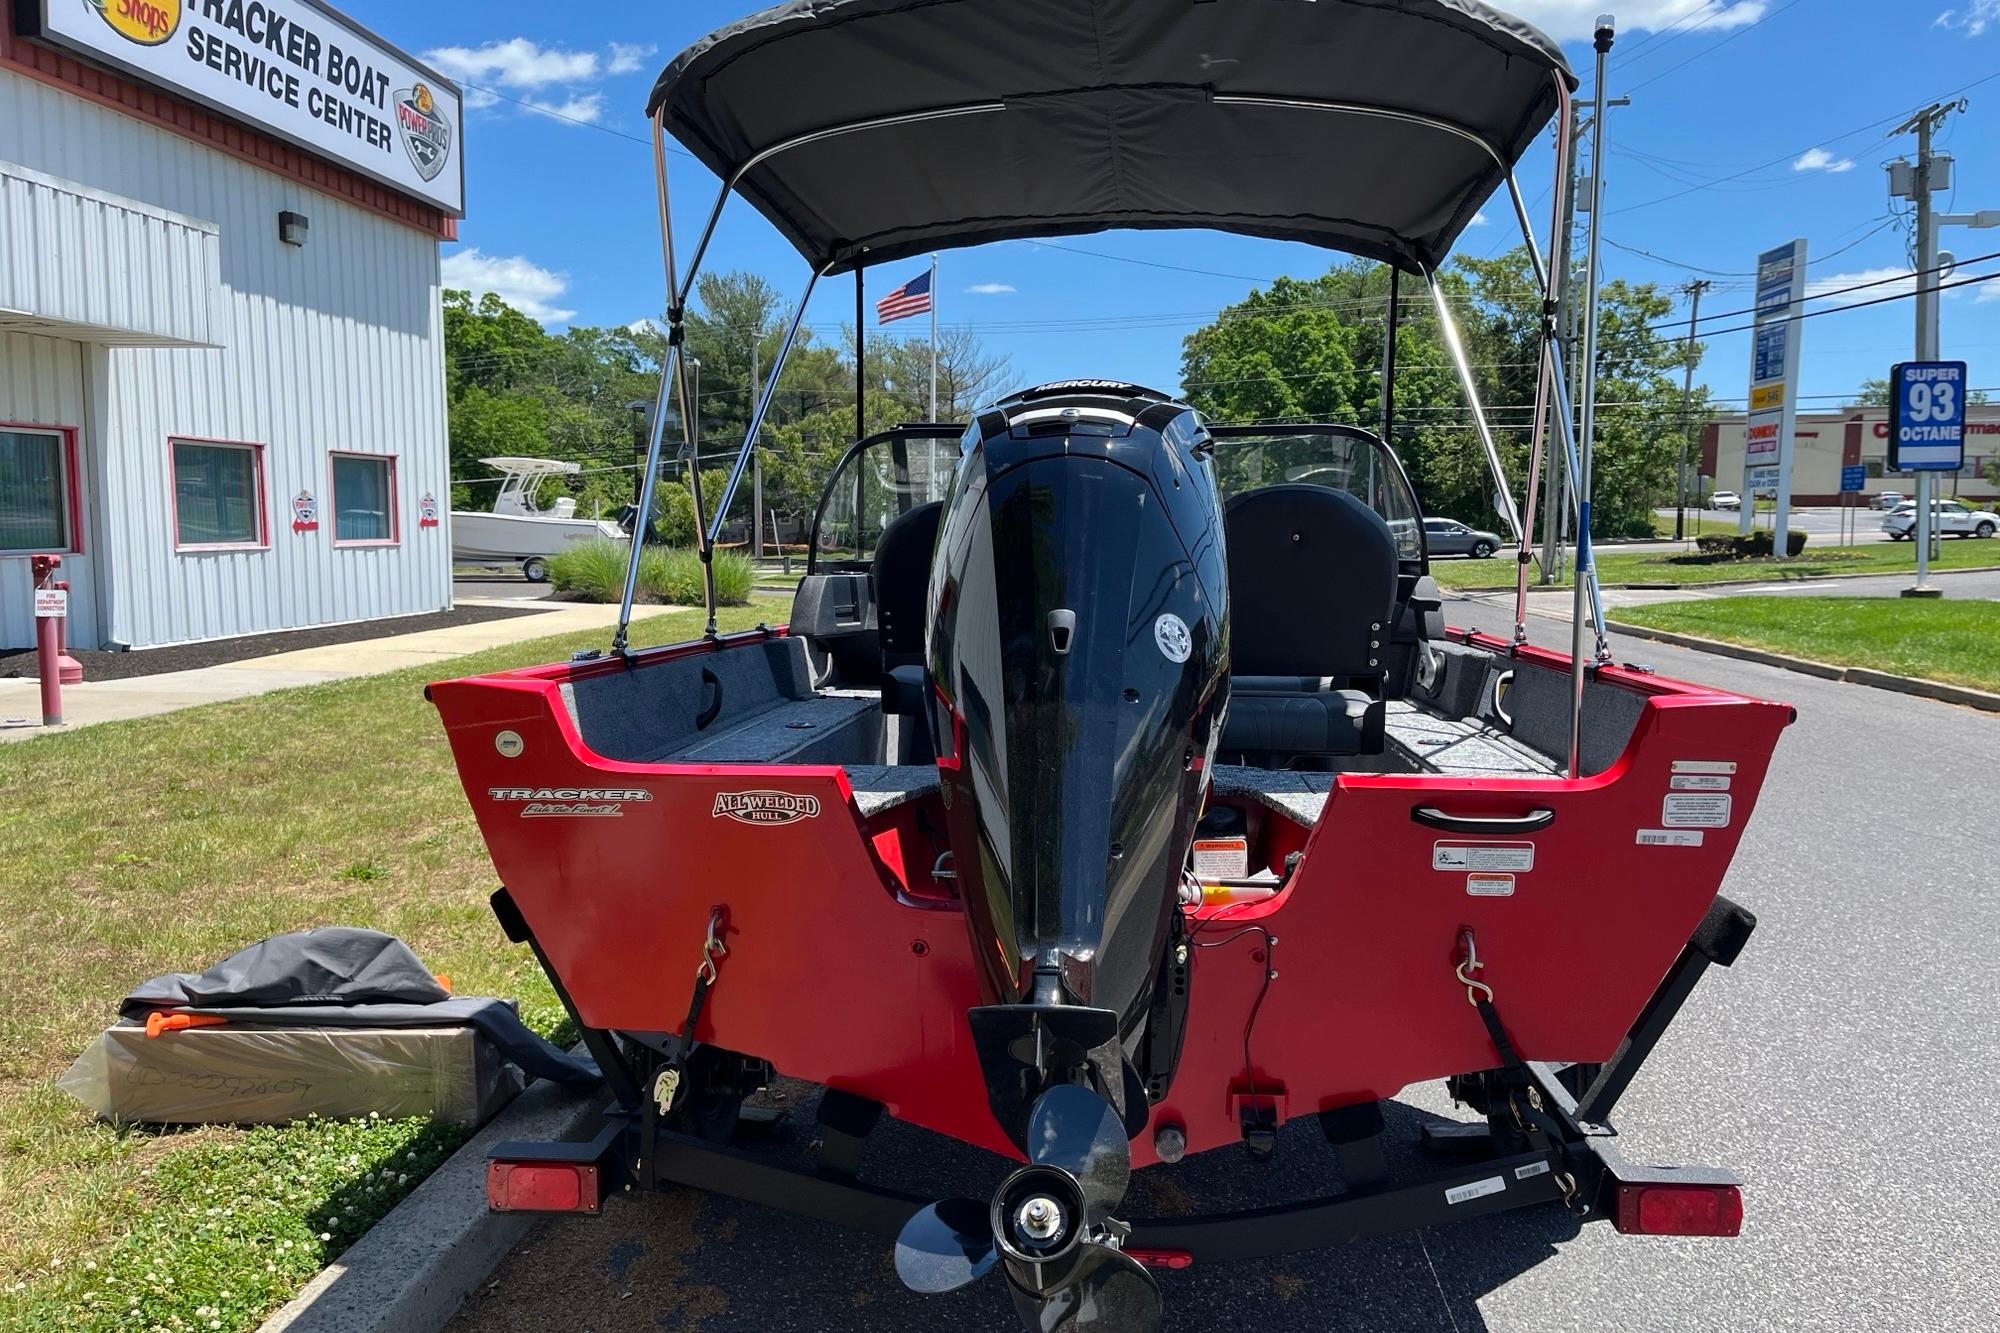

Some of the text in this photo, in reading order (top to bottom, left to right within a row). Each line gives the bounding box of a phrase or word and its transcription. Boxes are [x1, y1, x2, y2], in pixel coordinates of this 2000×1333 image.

[187, 0, 321, 76] RACKER
[327, 44, 390, 109] BOAT
[187, 26, 299, 108] SERVICE
[308, 87, 391, 153] CENTER
[1905, 368, 1960, 381] SUPER
[1035, 379, 1132, 392] MERCURY
[1909, 382, 1955, 422] 93
[1900, 425, 1961, 441] OCTANE
[489, 789, 646, 800] TRACKER
[525, 804, 549, 813] Fish
[552, 804, 570, 813] the
[715, 794, 816, 814] ALL WELDED
[752, 812, 782, 820] HULL
